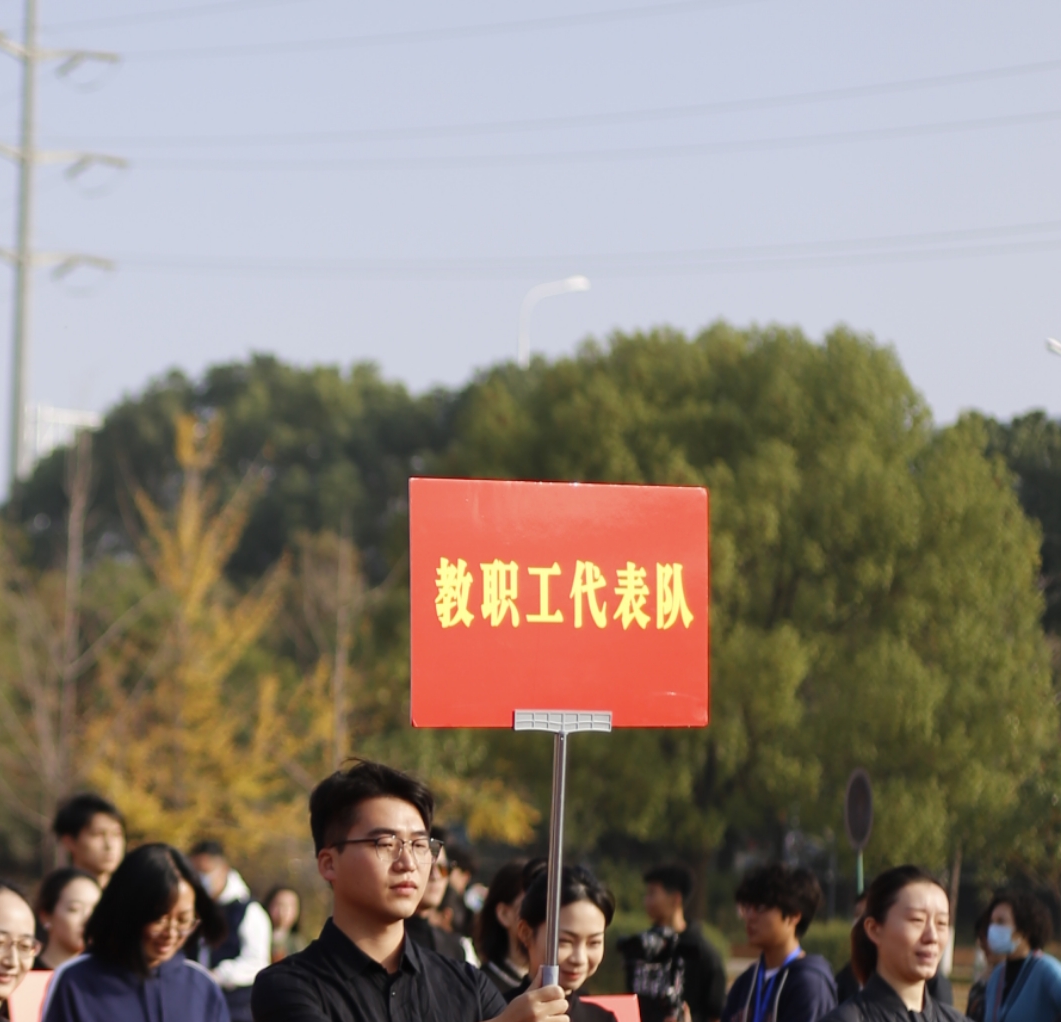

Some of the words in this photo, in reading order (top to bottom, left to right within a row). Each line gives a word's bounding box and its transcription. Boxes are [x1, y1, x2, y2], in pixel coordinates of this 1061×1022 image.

[434, 556, 694, 630] 教职工代表队
